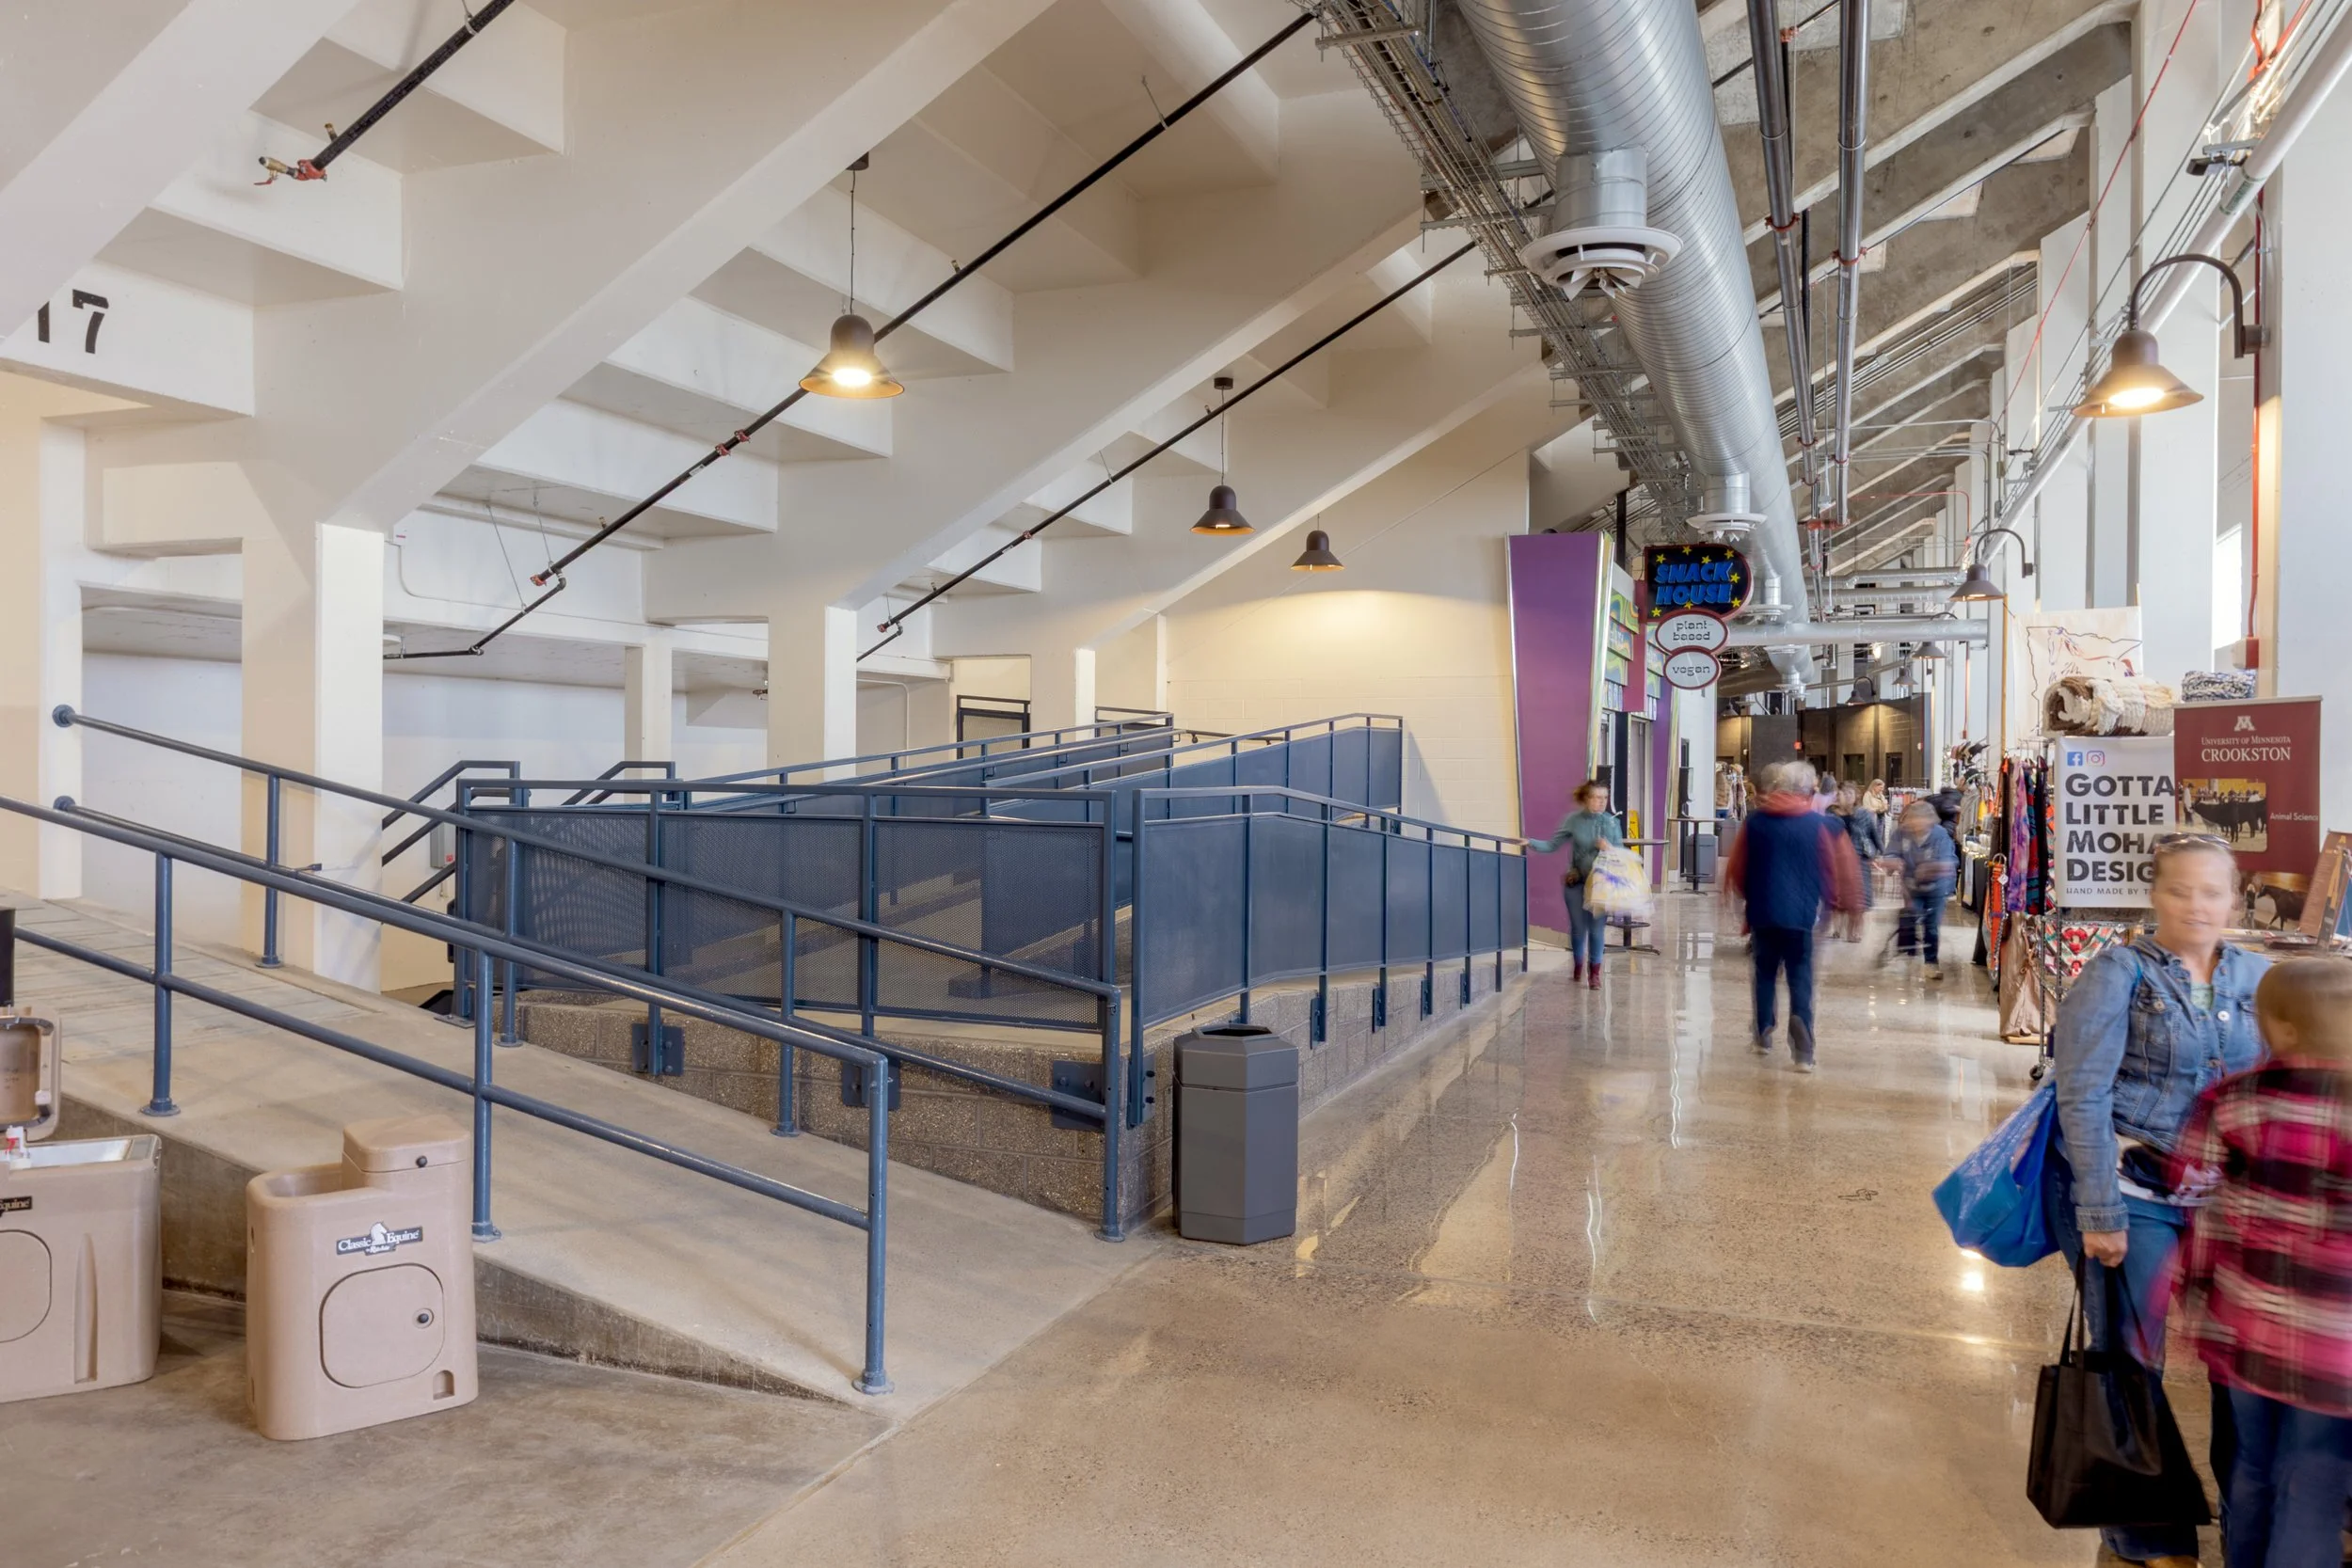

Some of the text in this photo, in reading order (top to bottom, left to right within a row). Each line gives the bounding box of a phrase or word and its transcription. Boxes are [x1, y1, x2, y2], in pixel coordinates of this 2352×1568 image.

[1655, 562, 1733, 583] SNACK
[1656, 584, 1732, 605] HOUSE
[1677, 621, 1713, 631] plant-
[2233, 716, 2256, 731] M
[2201, 747, 2291, 762] CROOKSTON
[2065, 773, 2175, 797] GOTTA
[2066, 802, 2164, 825] LITTLE
[2269, 812, 2292, 820] Animal
[2067, 859, 2154, 882] DESIG
[339, 1238, 372, 1251] Classic
[387, 1230, 420, 1244] Equine
